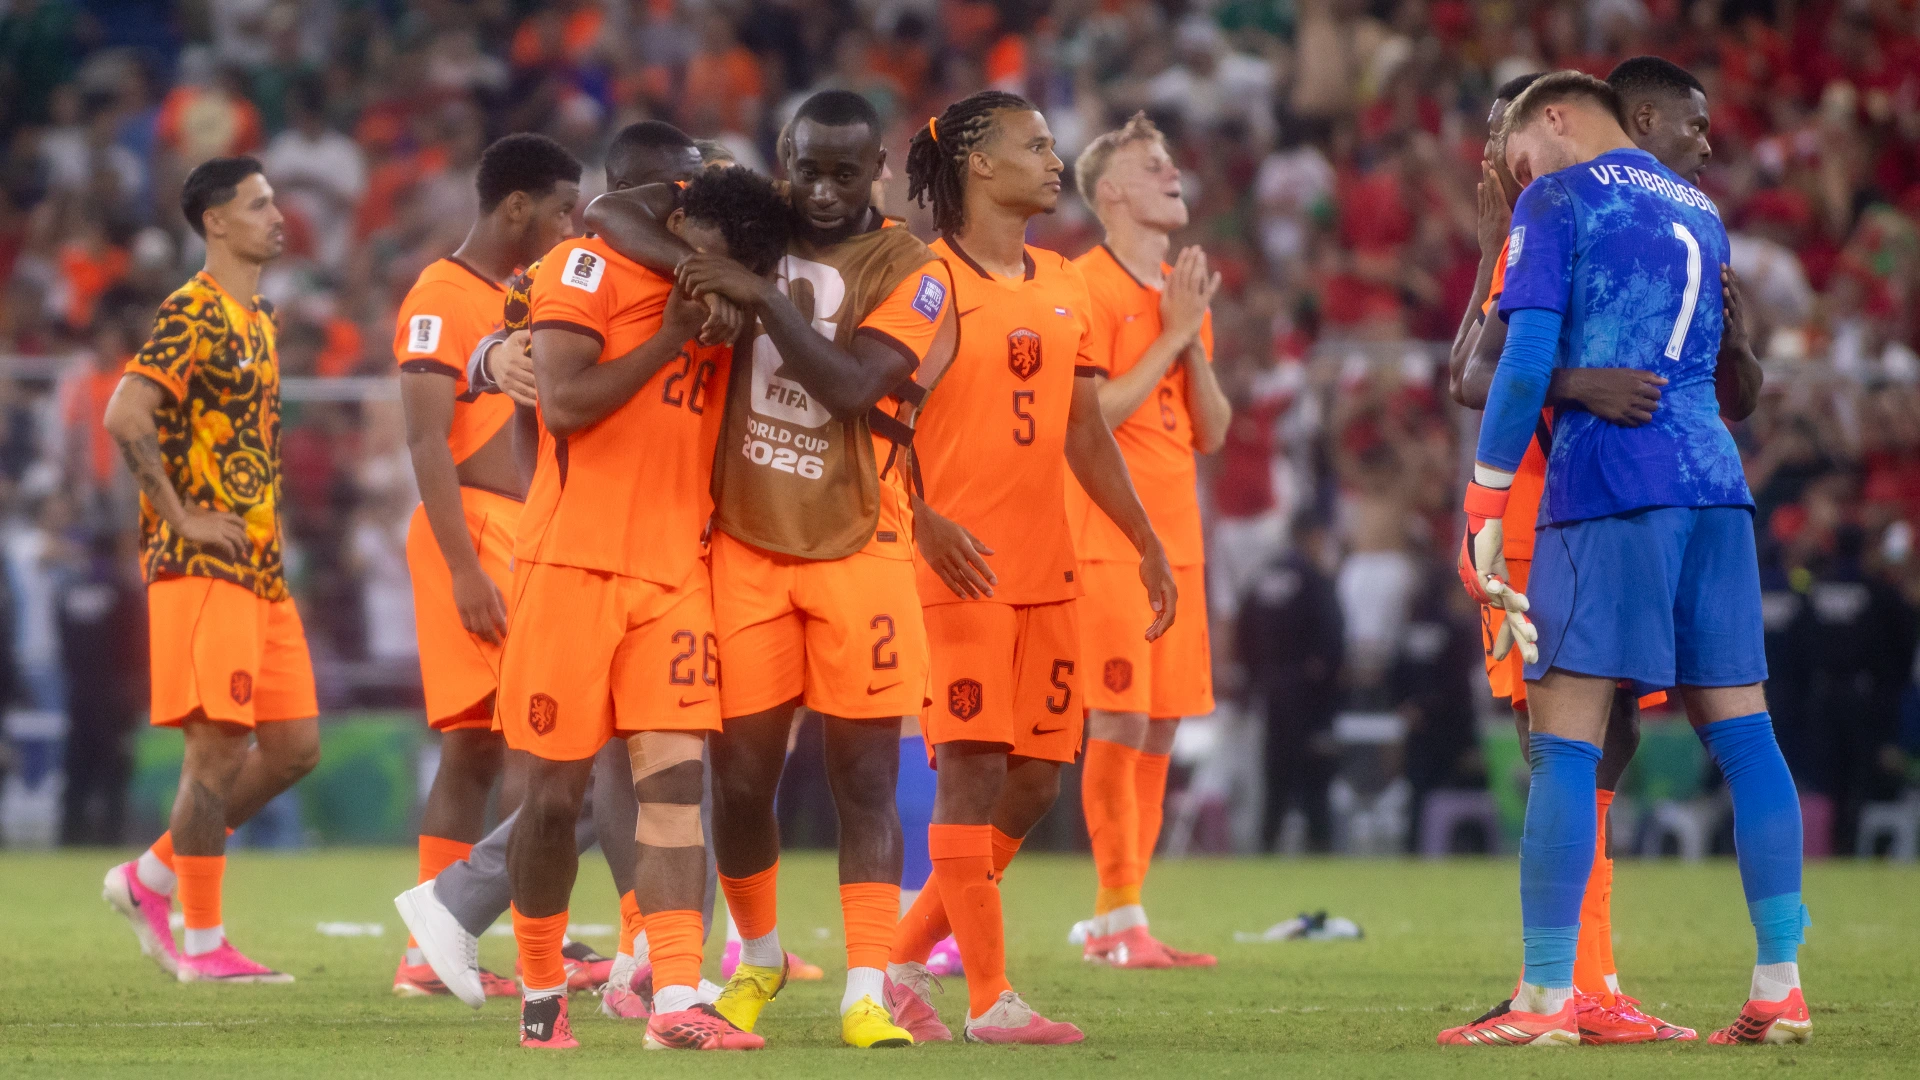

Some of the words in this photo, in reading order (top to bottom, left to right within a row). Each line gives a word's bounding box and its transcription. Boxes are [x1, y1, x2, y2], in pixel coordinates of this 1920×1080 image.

[1664, 222, 1701, 361] 1
[661, 351, 716, 416] 26
[765, 384, 808, 411] FIFA
[1158, 387, 1176, 431] 6
[794, 434, 829, 453] CUP
[1013, 390, 1035, 446] 5
[742, 434, 824, 479] 2026
[669, 630, 721, 687] 26
[869, 614, 898, 670] 2
[1046, 658, 1074, 715] 5
